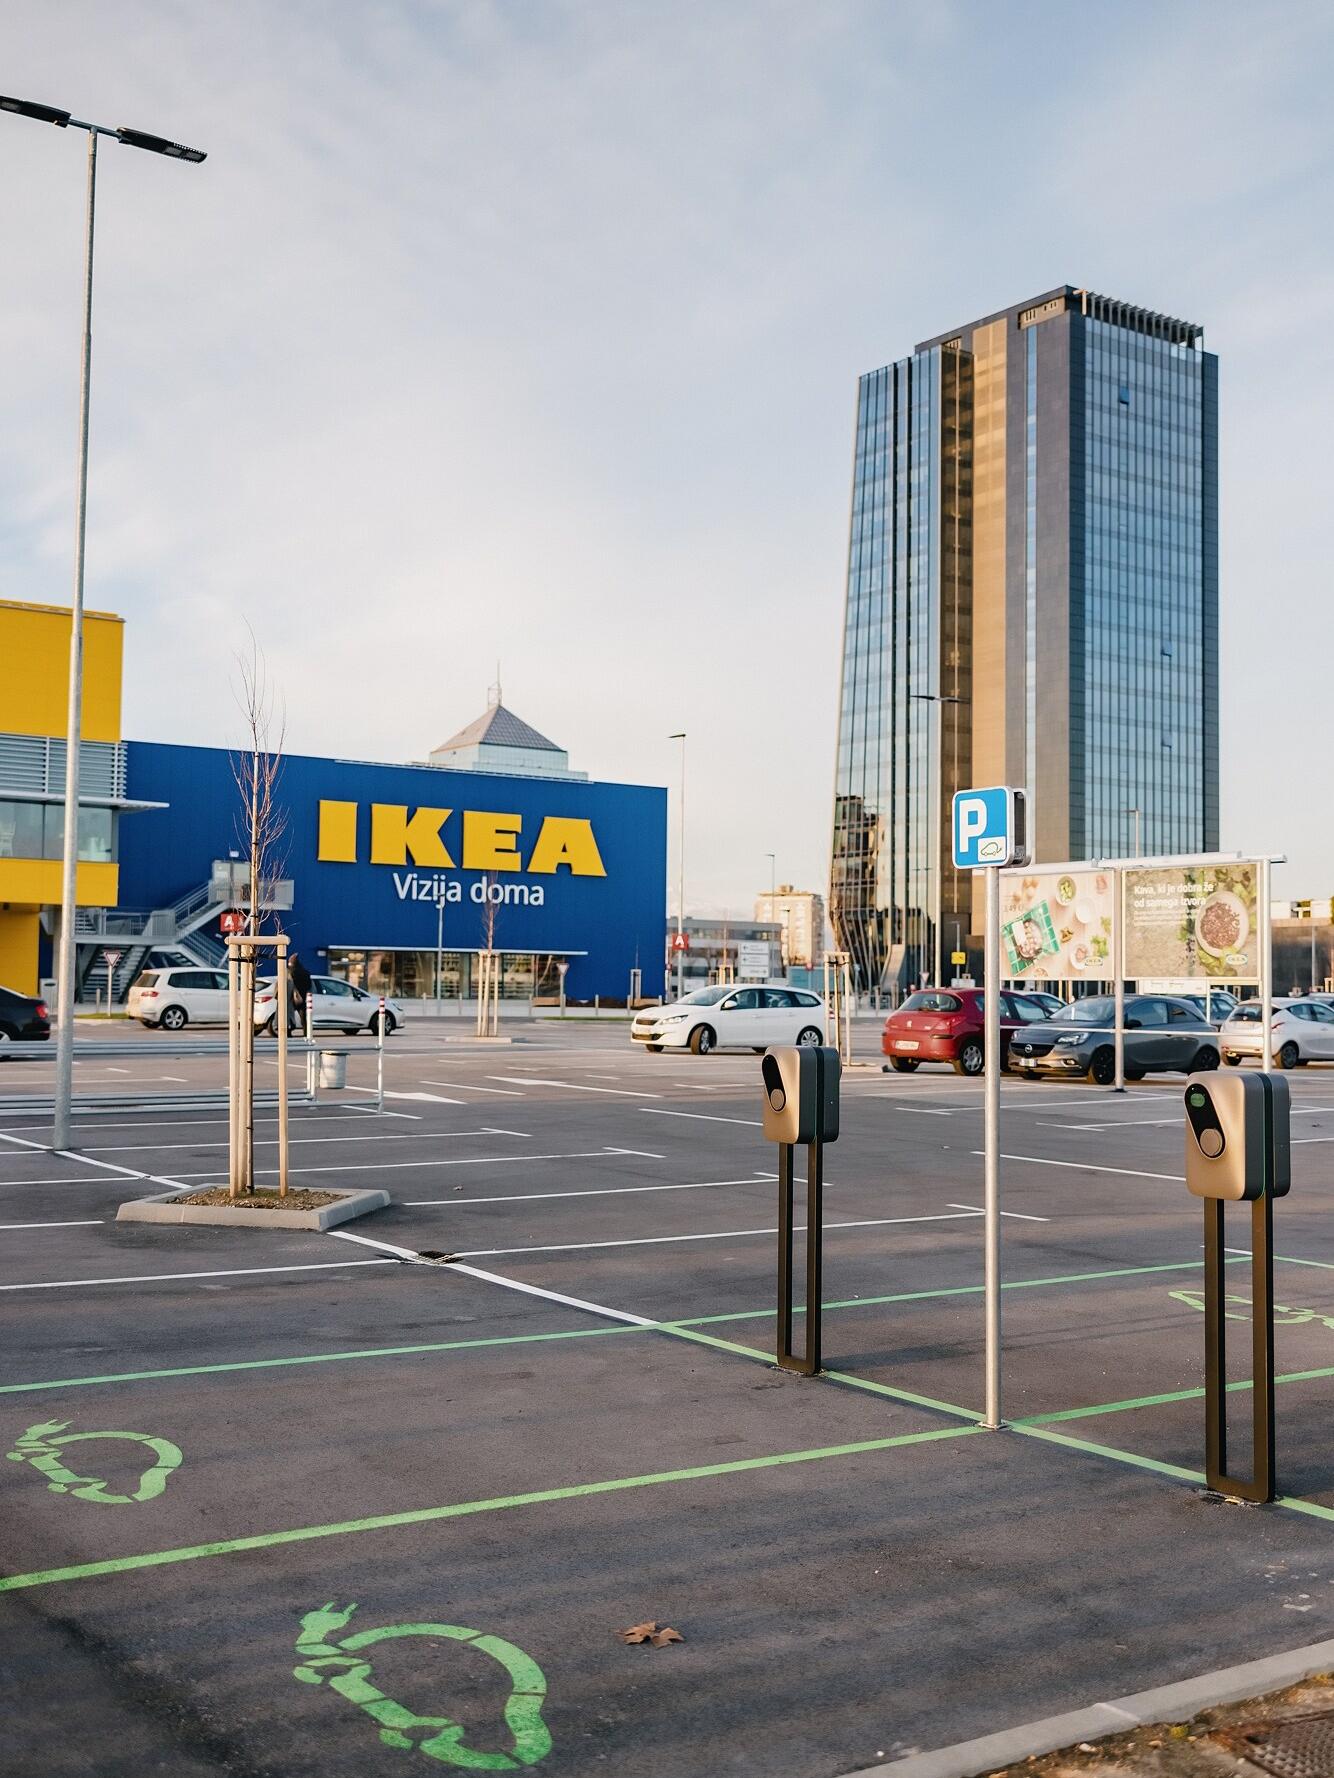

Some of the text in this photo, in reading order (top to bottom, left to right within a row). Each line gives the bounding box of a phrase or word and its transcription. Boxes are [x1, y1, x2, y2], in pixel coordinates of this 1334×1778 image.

[318, 799, 607, 876] IKEA
[959, 799, 987, 853] P
[393, 873, 544, 909] Vizija doma
[1134, 898, 1145, 908] od
[224, 915, 235, 929] A
[675, 935, 685, 949] A
